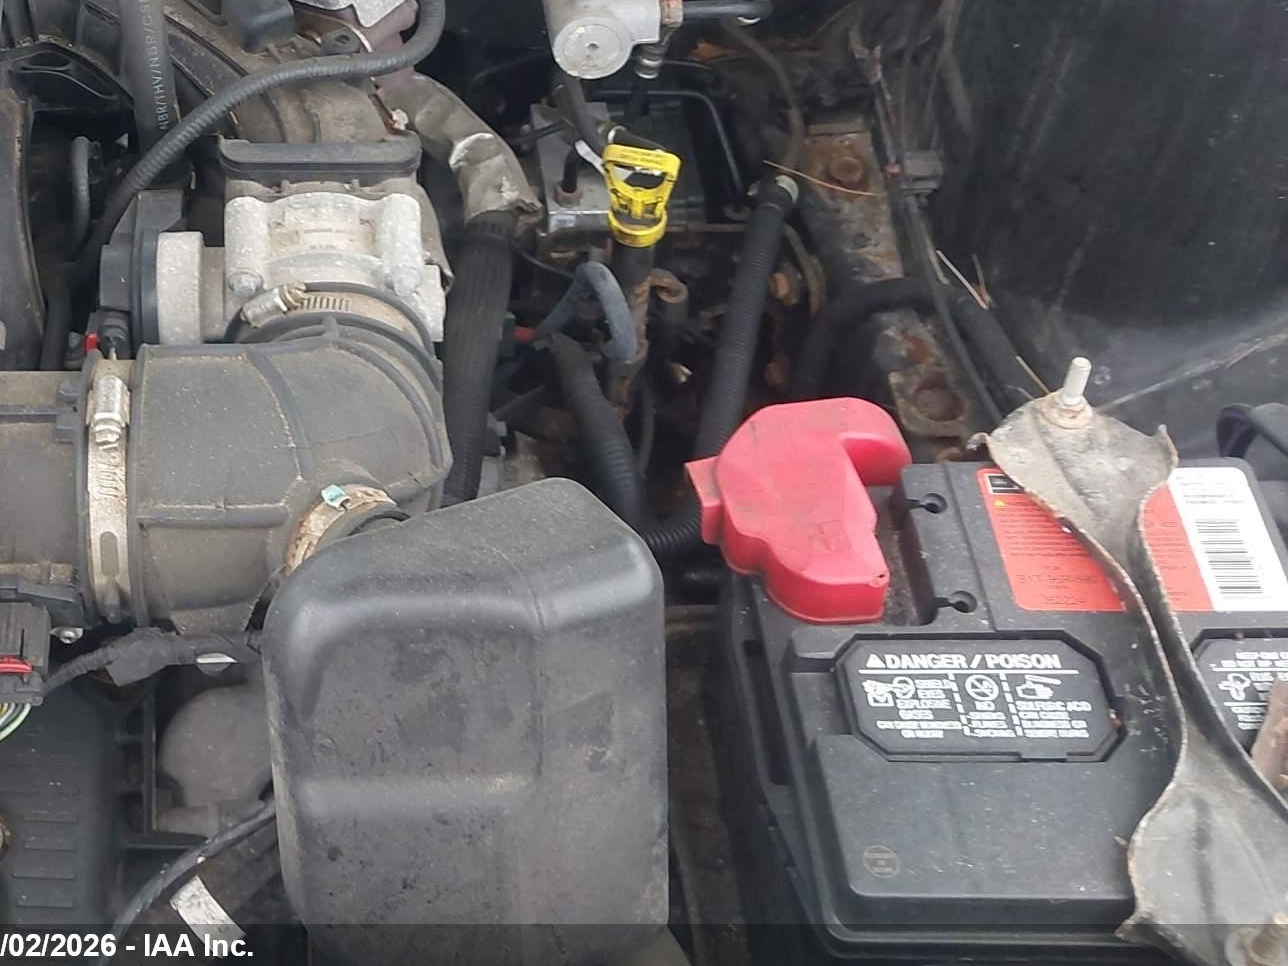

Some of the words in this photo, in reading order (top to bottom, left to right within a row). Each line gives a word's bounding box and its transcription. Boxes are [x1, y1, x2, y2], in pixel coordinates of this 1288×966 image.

[885, 653, 968, 669] DANGER
[970, 653, 982, 669] /
[984, 653, 1062, 669] POISON
